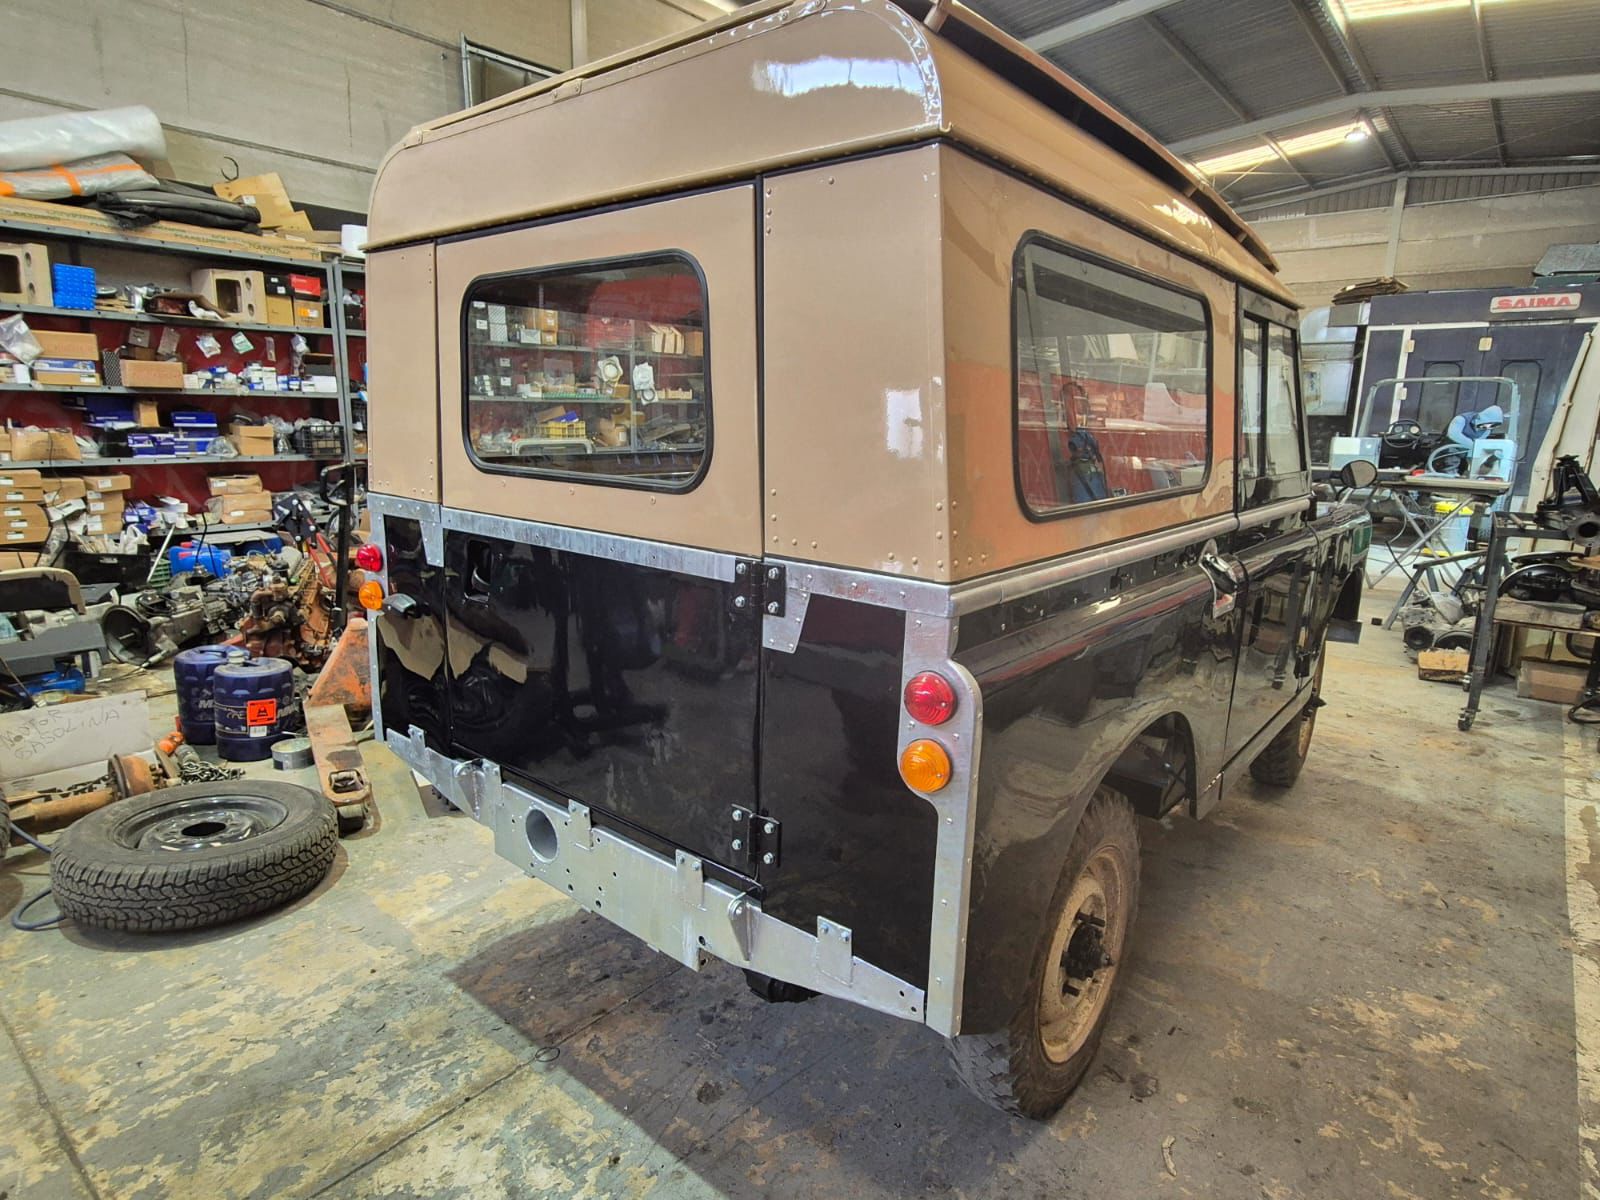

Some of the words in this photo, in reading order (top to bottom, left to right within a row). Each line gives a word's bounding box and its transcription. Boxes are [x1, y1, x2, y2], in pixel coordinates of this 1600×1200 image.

[1497, 296, 1571, 310] SAIMA
[0, 709, 62, 750] MOTOR
[14, 706, 120, 760] GASOLINA
